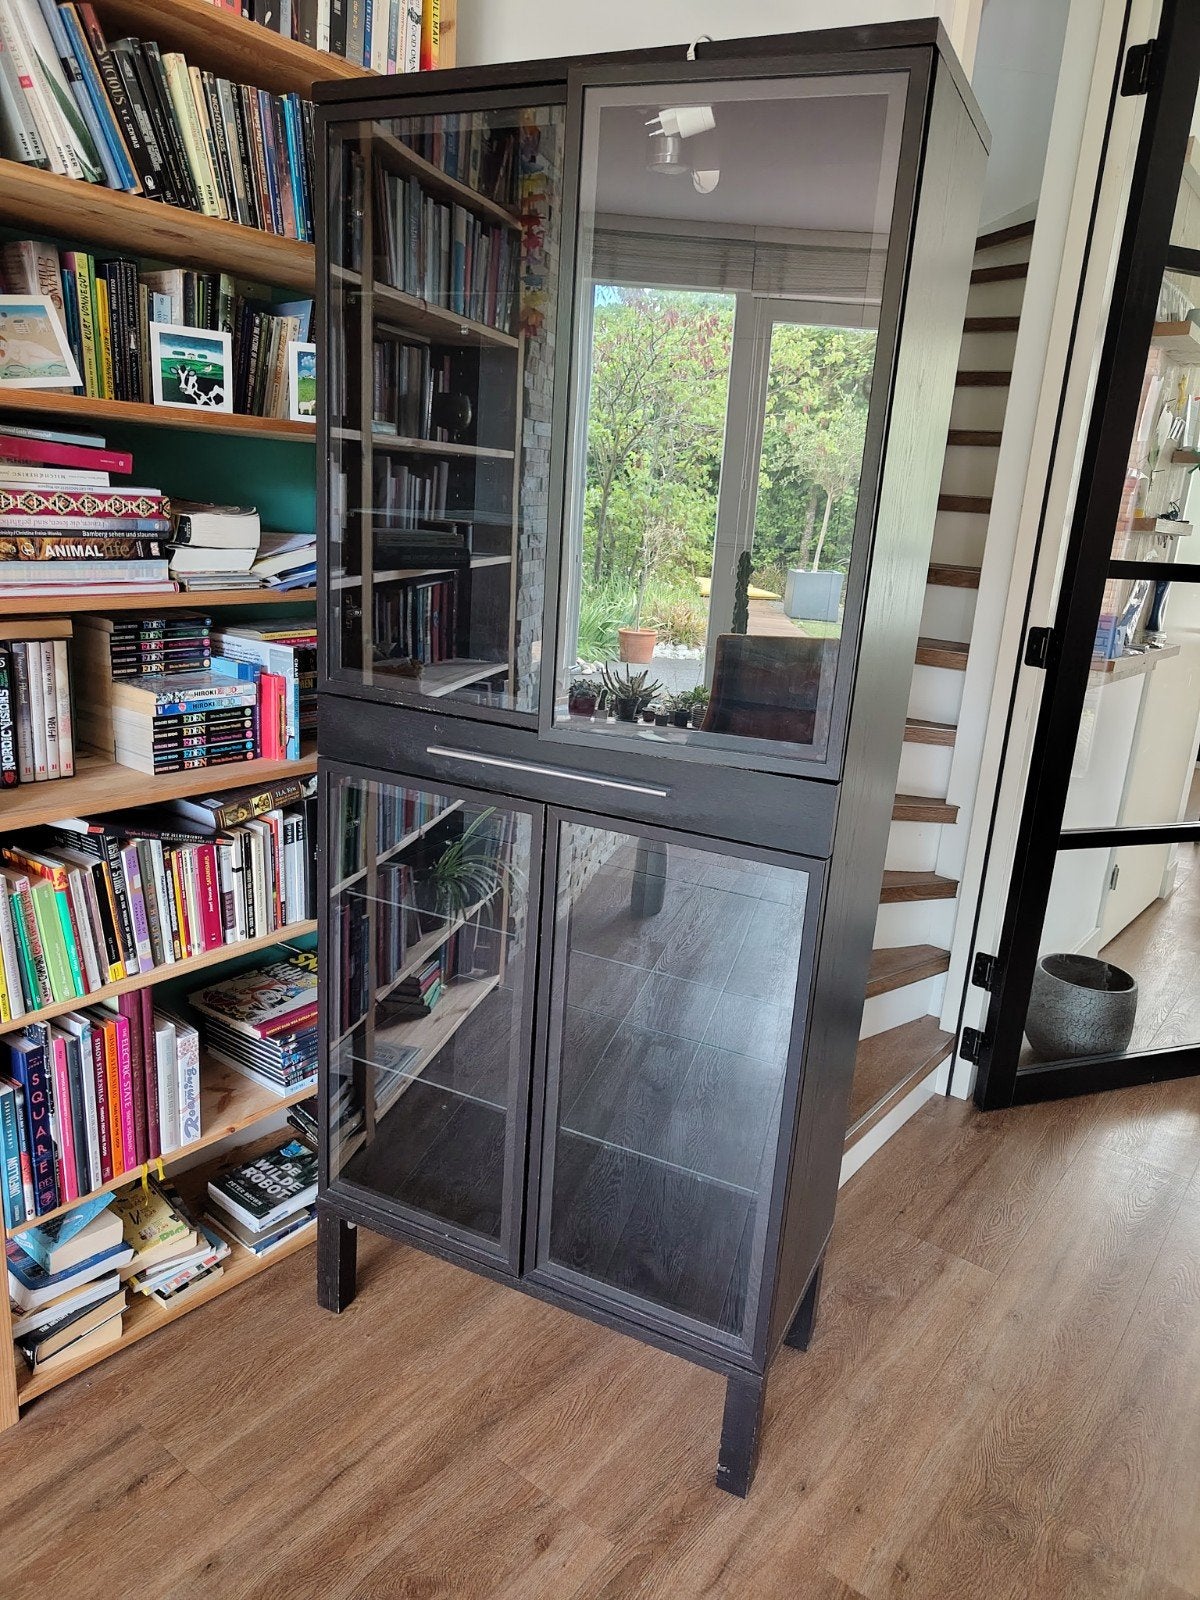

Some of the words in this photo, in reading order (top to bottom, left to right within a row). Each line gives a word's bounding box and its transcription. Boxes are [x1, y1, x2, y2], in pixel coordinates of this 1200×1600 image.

[432, 0, 440, 46] ULLMAN
[409, 49, 417, 73] OMEN
[100, 55, 127, 105] VICIOUS
[126, 123, 140, 149] SCHWAB
[211, 93, 226, 153] NIGHTWINGS
[19, 133, 31, 157] PIPER
[29, 132, 42, 156] PIPER
[66, 144, 78, 168] PIPER
[197, 185, 206, 205] PIPER
[206, 184, 215, 205] PIPER
[38, 256, 48, 296] CHILD
[78, 272, 91, 317] VONNEGUT
[80, 319, 93, 341] KURT
[105, 356, 114, 396] VONNEGUT
[1, 494, 24, 509] HE
[82, 531, 108, 539] Bamberg
[45, 544, 104, 557] ANIMAL
[140, 631, 163, 639] EDEN
[143, 620, 166, 629] EDEN
[141, 641, 164, 650] EDEN
[142, 652, 164, 661] EDEN
[142, 663, 165, 672] EDEN
[47, 716, 56, 742] WEIGHT
[183, 712, 206, 724] EDEN
[183, 725, 206, 736] EDEN
[183, 736, 206, 747] EDEN
[183, 748, 207, 759] EDEN
[184, 758, 208, 769] EDEN
[107, 844, 117, 861] ASH
[110, 861, 119, 870] OF
[204, 855, 212, 886] SATANISMUS
[112, 871, 122, 894] STARS
[94, 1038, 102, 1062] SIMON
[122, 1038, 131, 1079] ELECTRIC
[96, 1063, 105, 1104] STÅLENHAG
[123, 1081, 132, 1109] STATE
[184, 1066, 199, 1140] Roaming
[31, 1073, 48, 1174] SQUARE
[7, 1155, 21, 1198] UNFOLLOW
[255, 1158, 305, 1192] WILDE
[280, 1162, 302, 1177] DE
[38, 1177, 53, 1189] EYES
[227, 1181, 245, 1194] PETER
[244, 1191, 263, 1206] BROWN
[241, 1166, 293, 1200] ROBOT
